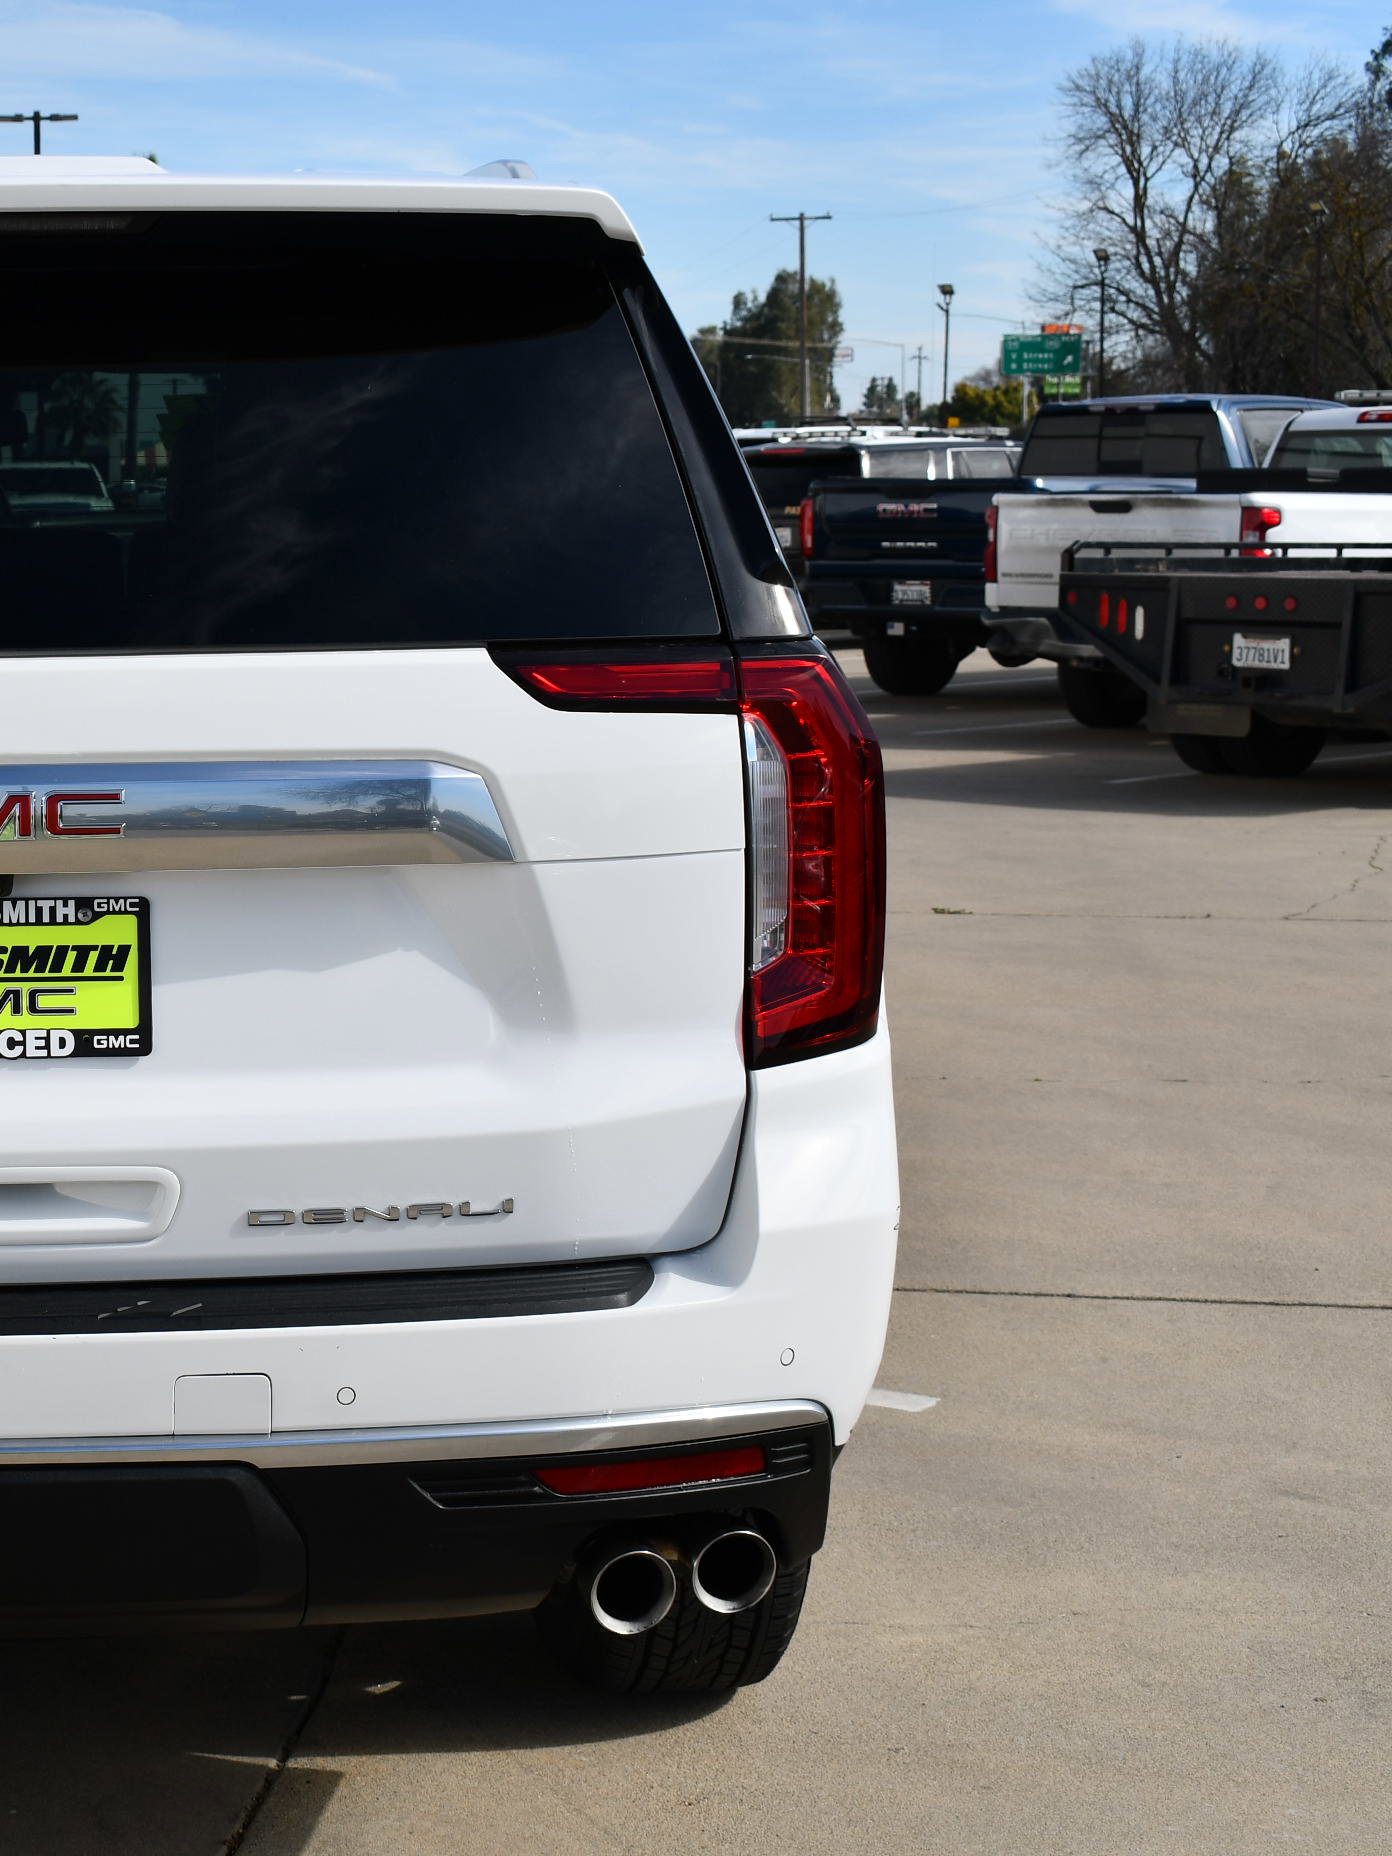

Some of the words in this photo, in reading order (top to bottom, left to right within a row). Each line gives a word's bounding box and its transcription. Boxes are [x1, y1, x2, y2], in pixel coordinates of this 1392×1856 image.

[876, 503, 938, 518] GMC
[1235, 646, 1286, 665] 37781V1
[93, 899, 140, 912] GMC
[93, 1035, 140, 1049] GMC
[247, 1197, 515, 1227] DENALI
